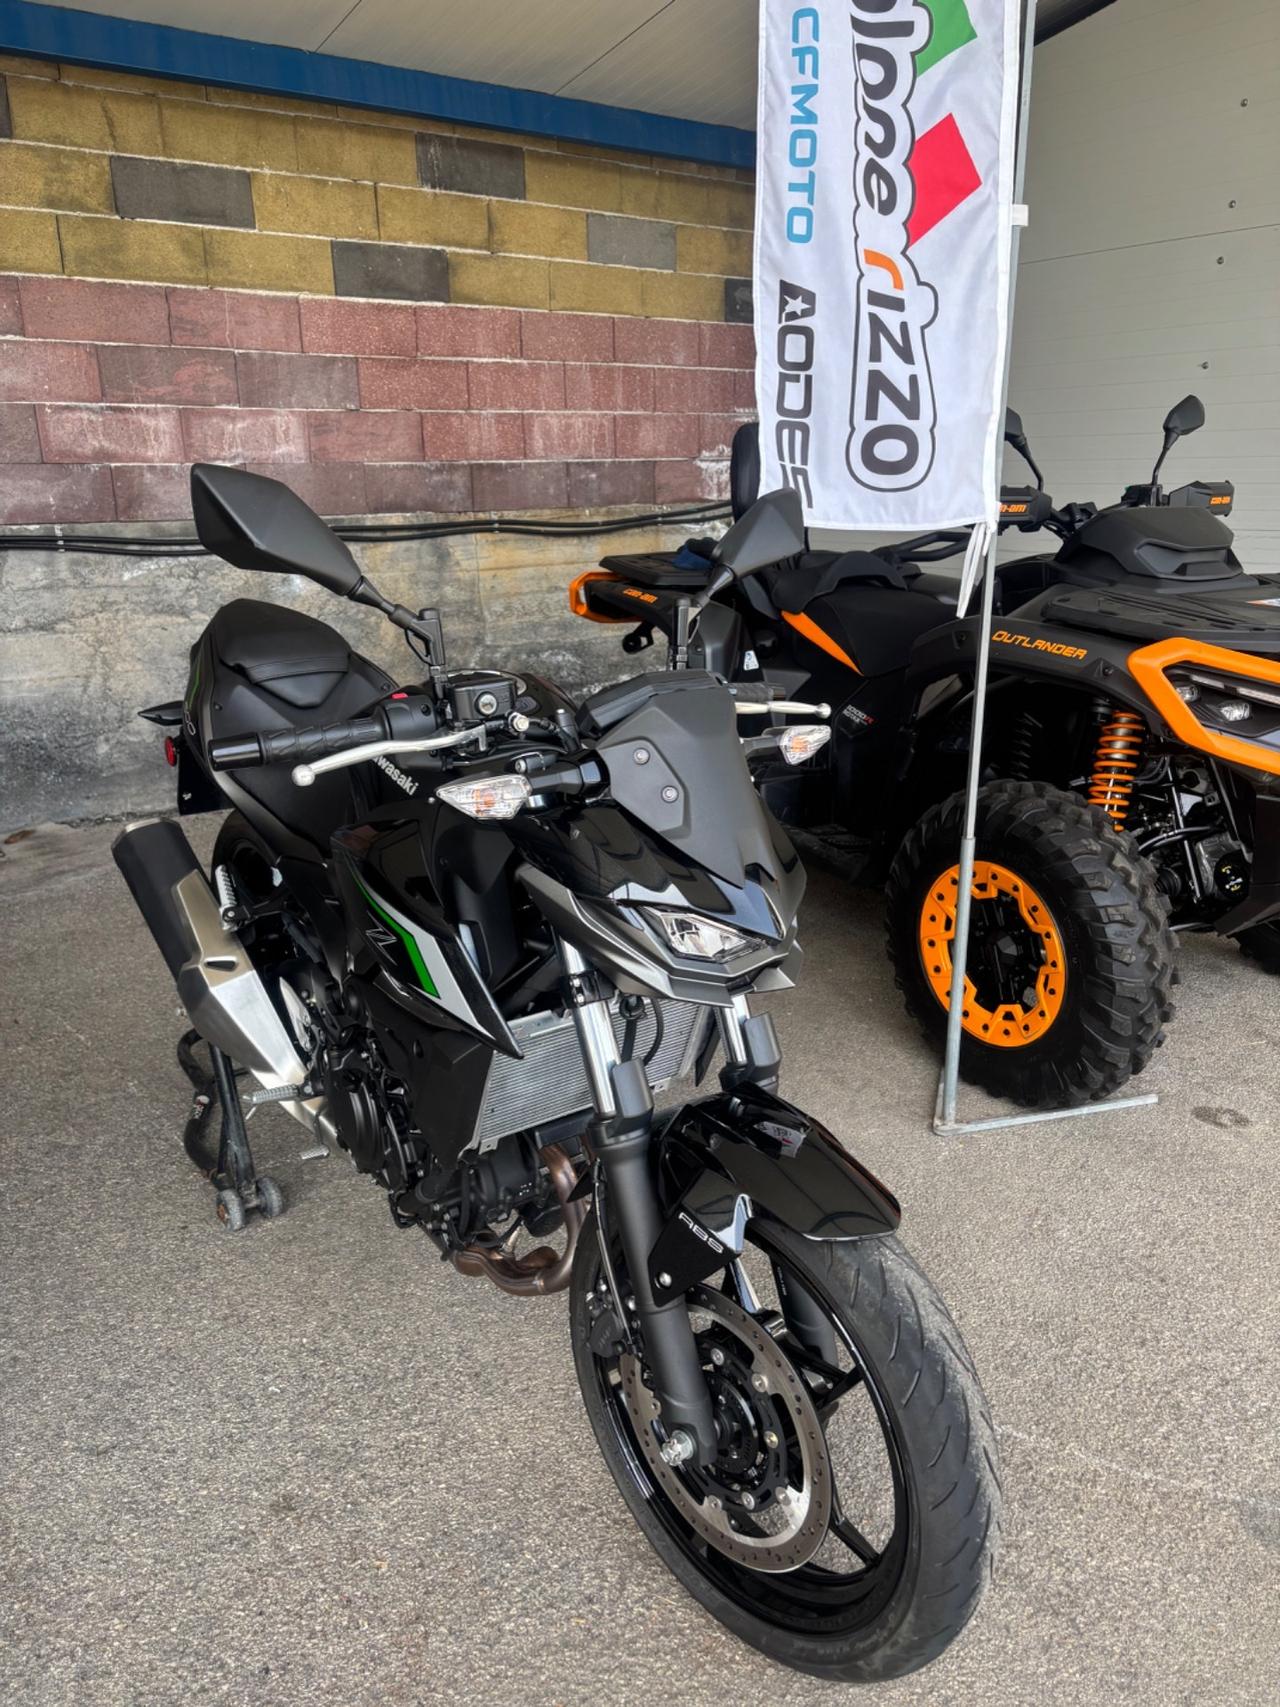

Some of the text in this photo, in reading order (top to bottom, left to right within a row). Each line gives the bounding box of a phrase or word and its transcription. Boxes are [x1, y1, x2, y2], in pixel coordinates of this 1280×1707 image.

[786, 7, 819, 244] CFMOTO
[775, 279, 817, 509] AODES
[991, 630, 1088, 660] OUTLANDER
[372, 755, 420, 796] wasaki
[678, 1211, 724, 1254] ABS
